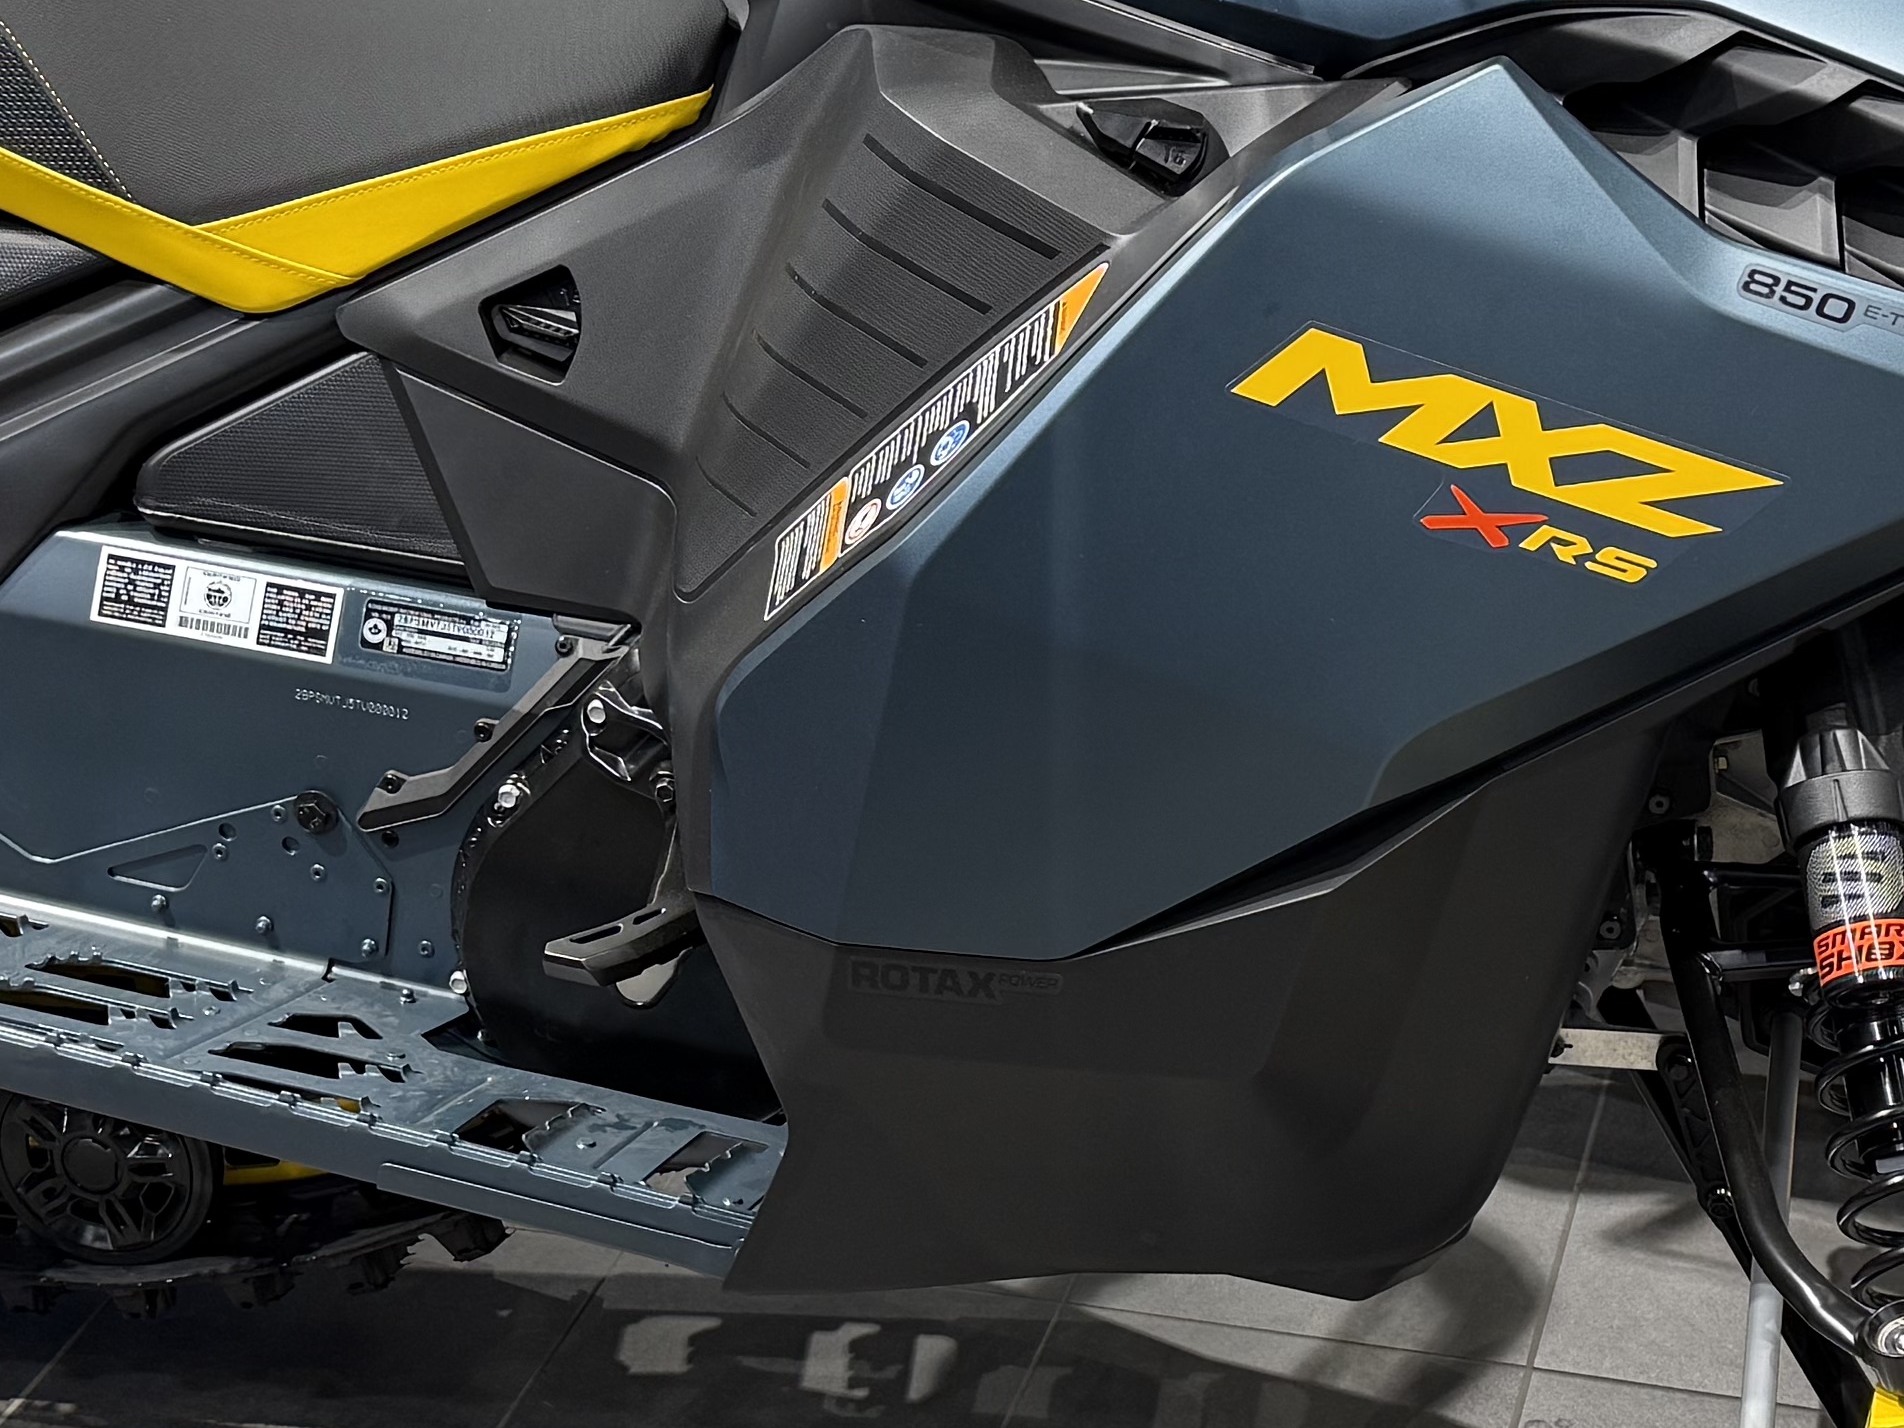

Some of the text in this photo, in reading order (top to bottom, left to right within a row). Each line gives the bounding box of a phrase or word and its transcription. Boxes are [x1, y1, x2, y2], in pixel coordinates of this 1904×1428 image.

[1741, 268, 1857, 324] 850
[1230, 327, 1785, 539] MXZ
[850, 959, 1060, 1000] ROTAX POWER
